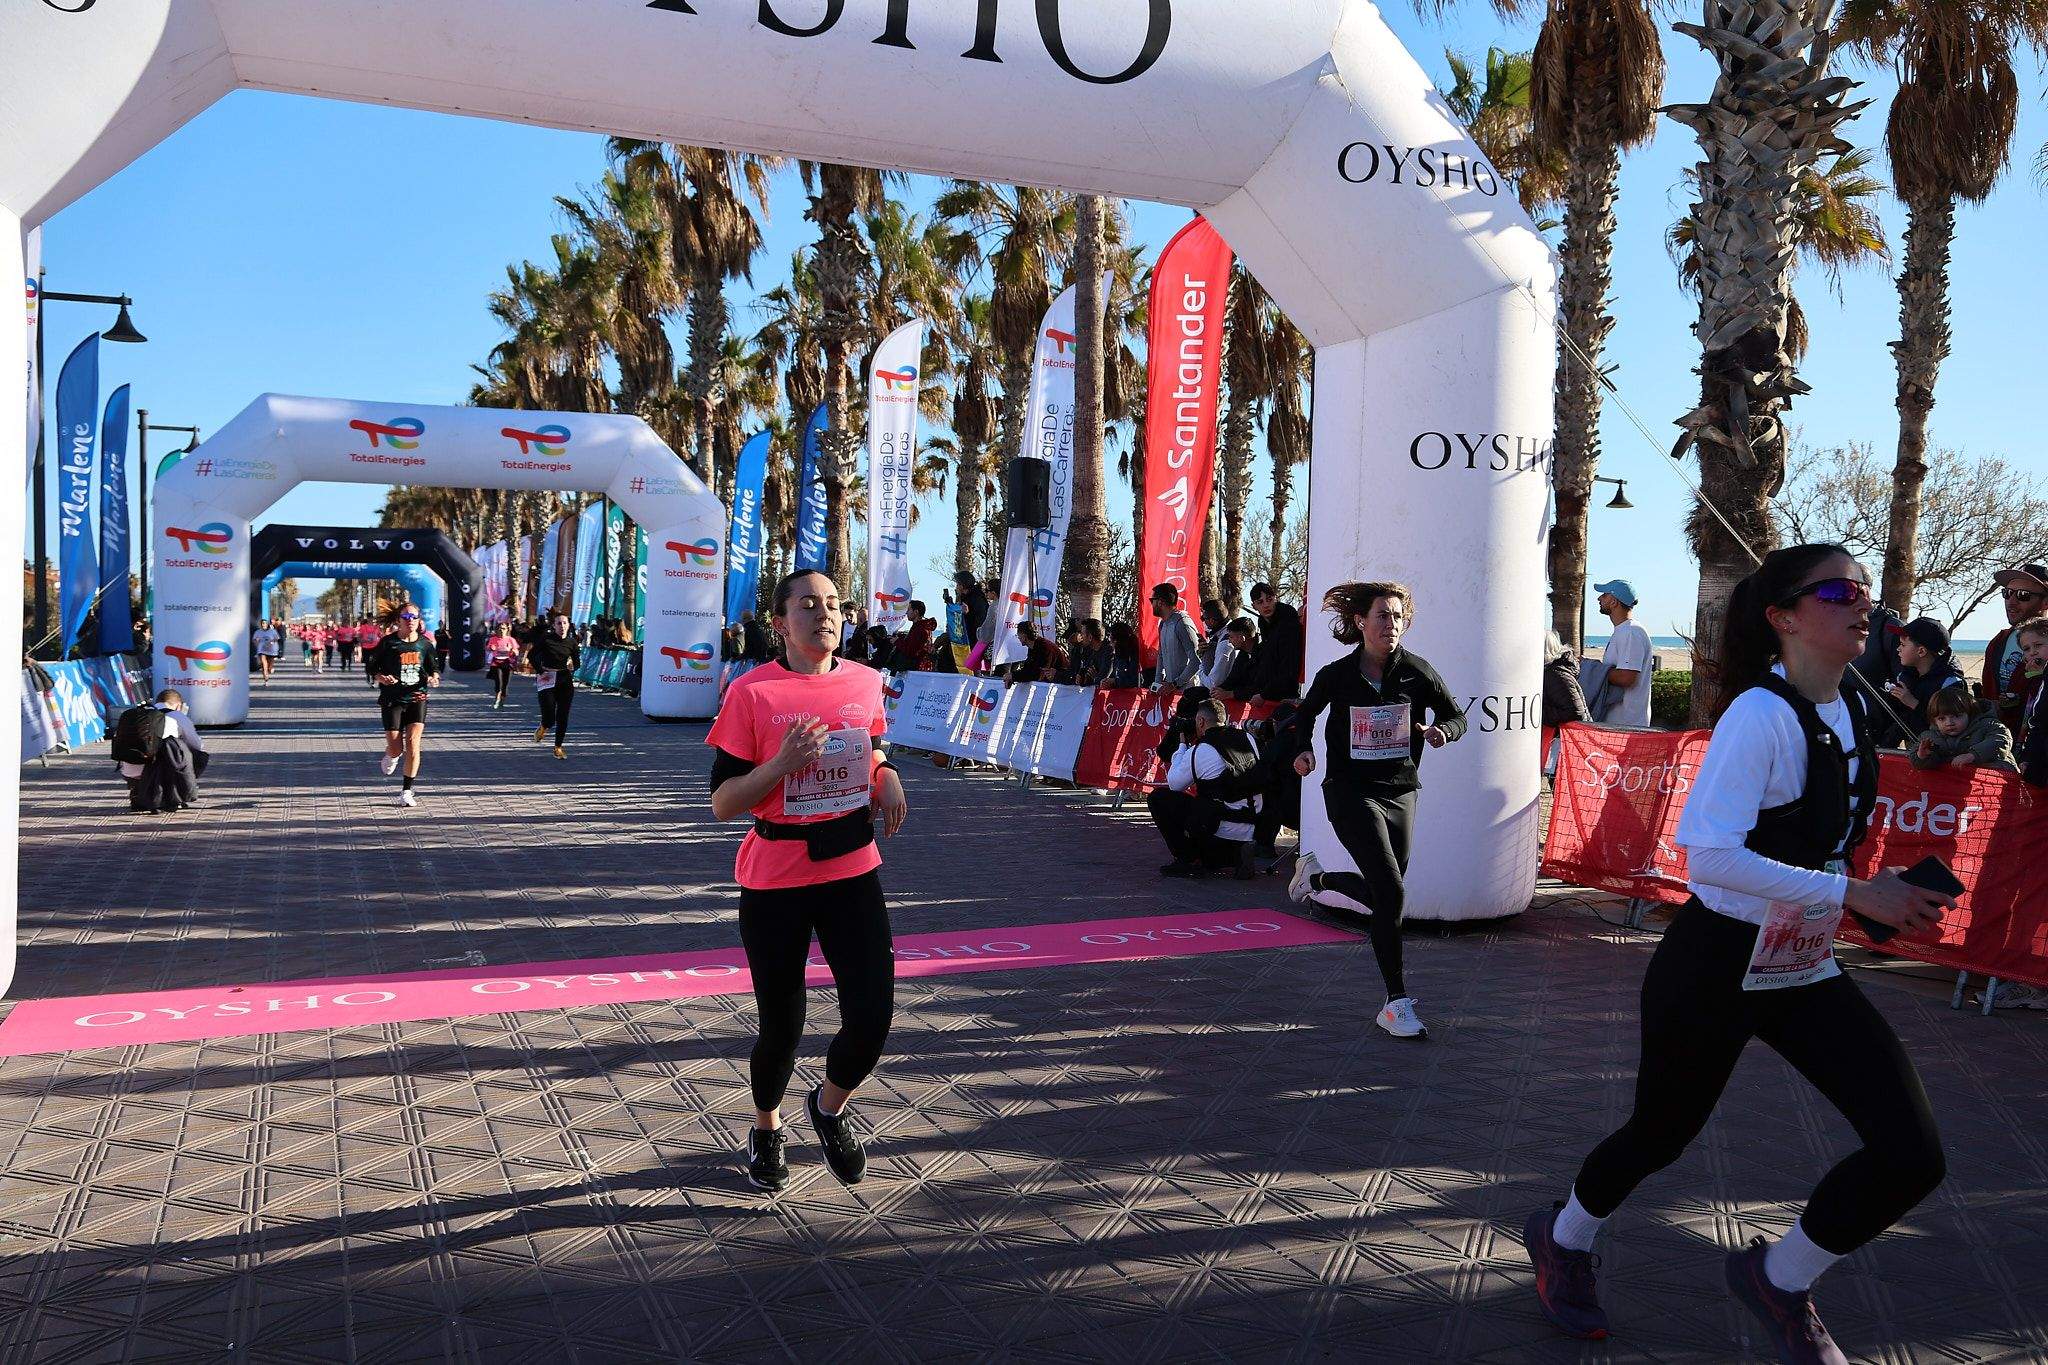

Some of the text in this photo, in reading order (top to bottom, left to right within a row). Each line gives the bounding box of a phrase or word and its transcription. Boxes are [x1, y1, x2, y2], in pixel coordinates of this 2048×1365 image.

[1337, 141, 1498, 197] OYSHO
[1042, 358, 1075, 369] TotalEne
[1167, 273, 1206, 469] Santander
[350, 453, 426, 467] TotalEnergies
[1409, 431, 1552, 475] OYSHO
[501, 460, 572, 473] TotalEnergies
[61, 422, 94, 537] Marlene
[730, 488, 760, 574] Marlene
[295, 538, 415, 551] VOLVO
[165, 559, 234, 570] TotalEnergies
[664, 569, 718, 580] TotalEnergies
[462, 583, 471, 660] VOLVO
[163, 677, 231, 688] TotalEnergies
[659, 674, 714, 685] TotalEnergies
[772, 711, 811, 725] OYSHO
[1371, 728, 1393, 739] 016
[815, 766, 849, 783] 016
[1582, 751, 1691, 800] Sports
[794, 802, 823, 812] OYSHO
[1080, 922, 1281, 945] OYSHO
[1792, 932, 1826, 953] 016
[471, 963, 741, 995] OYSHO
[74, 991, 396, 1027] OYSHO
